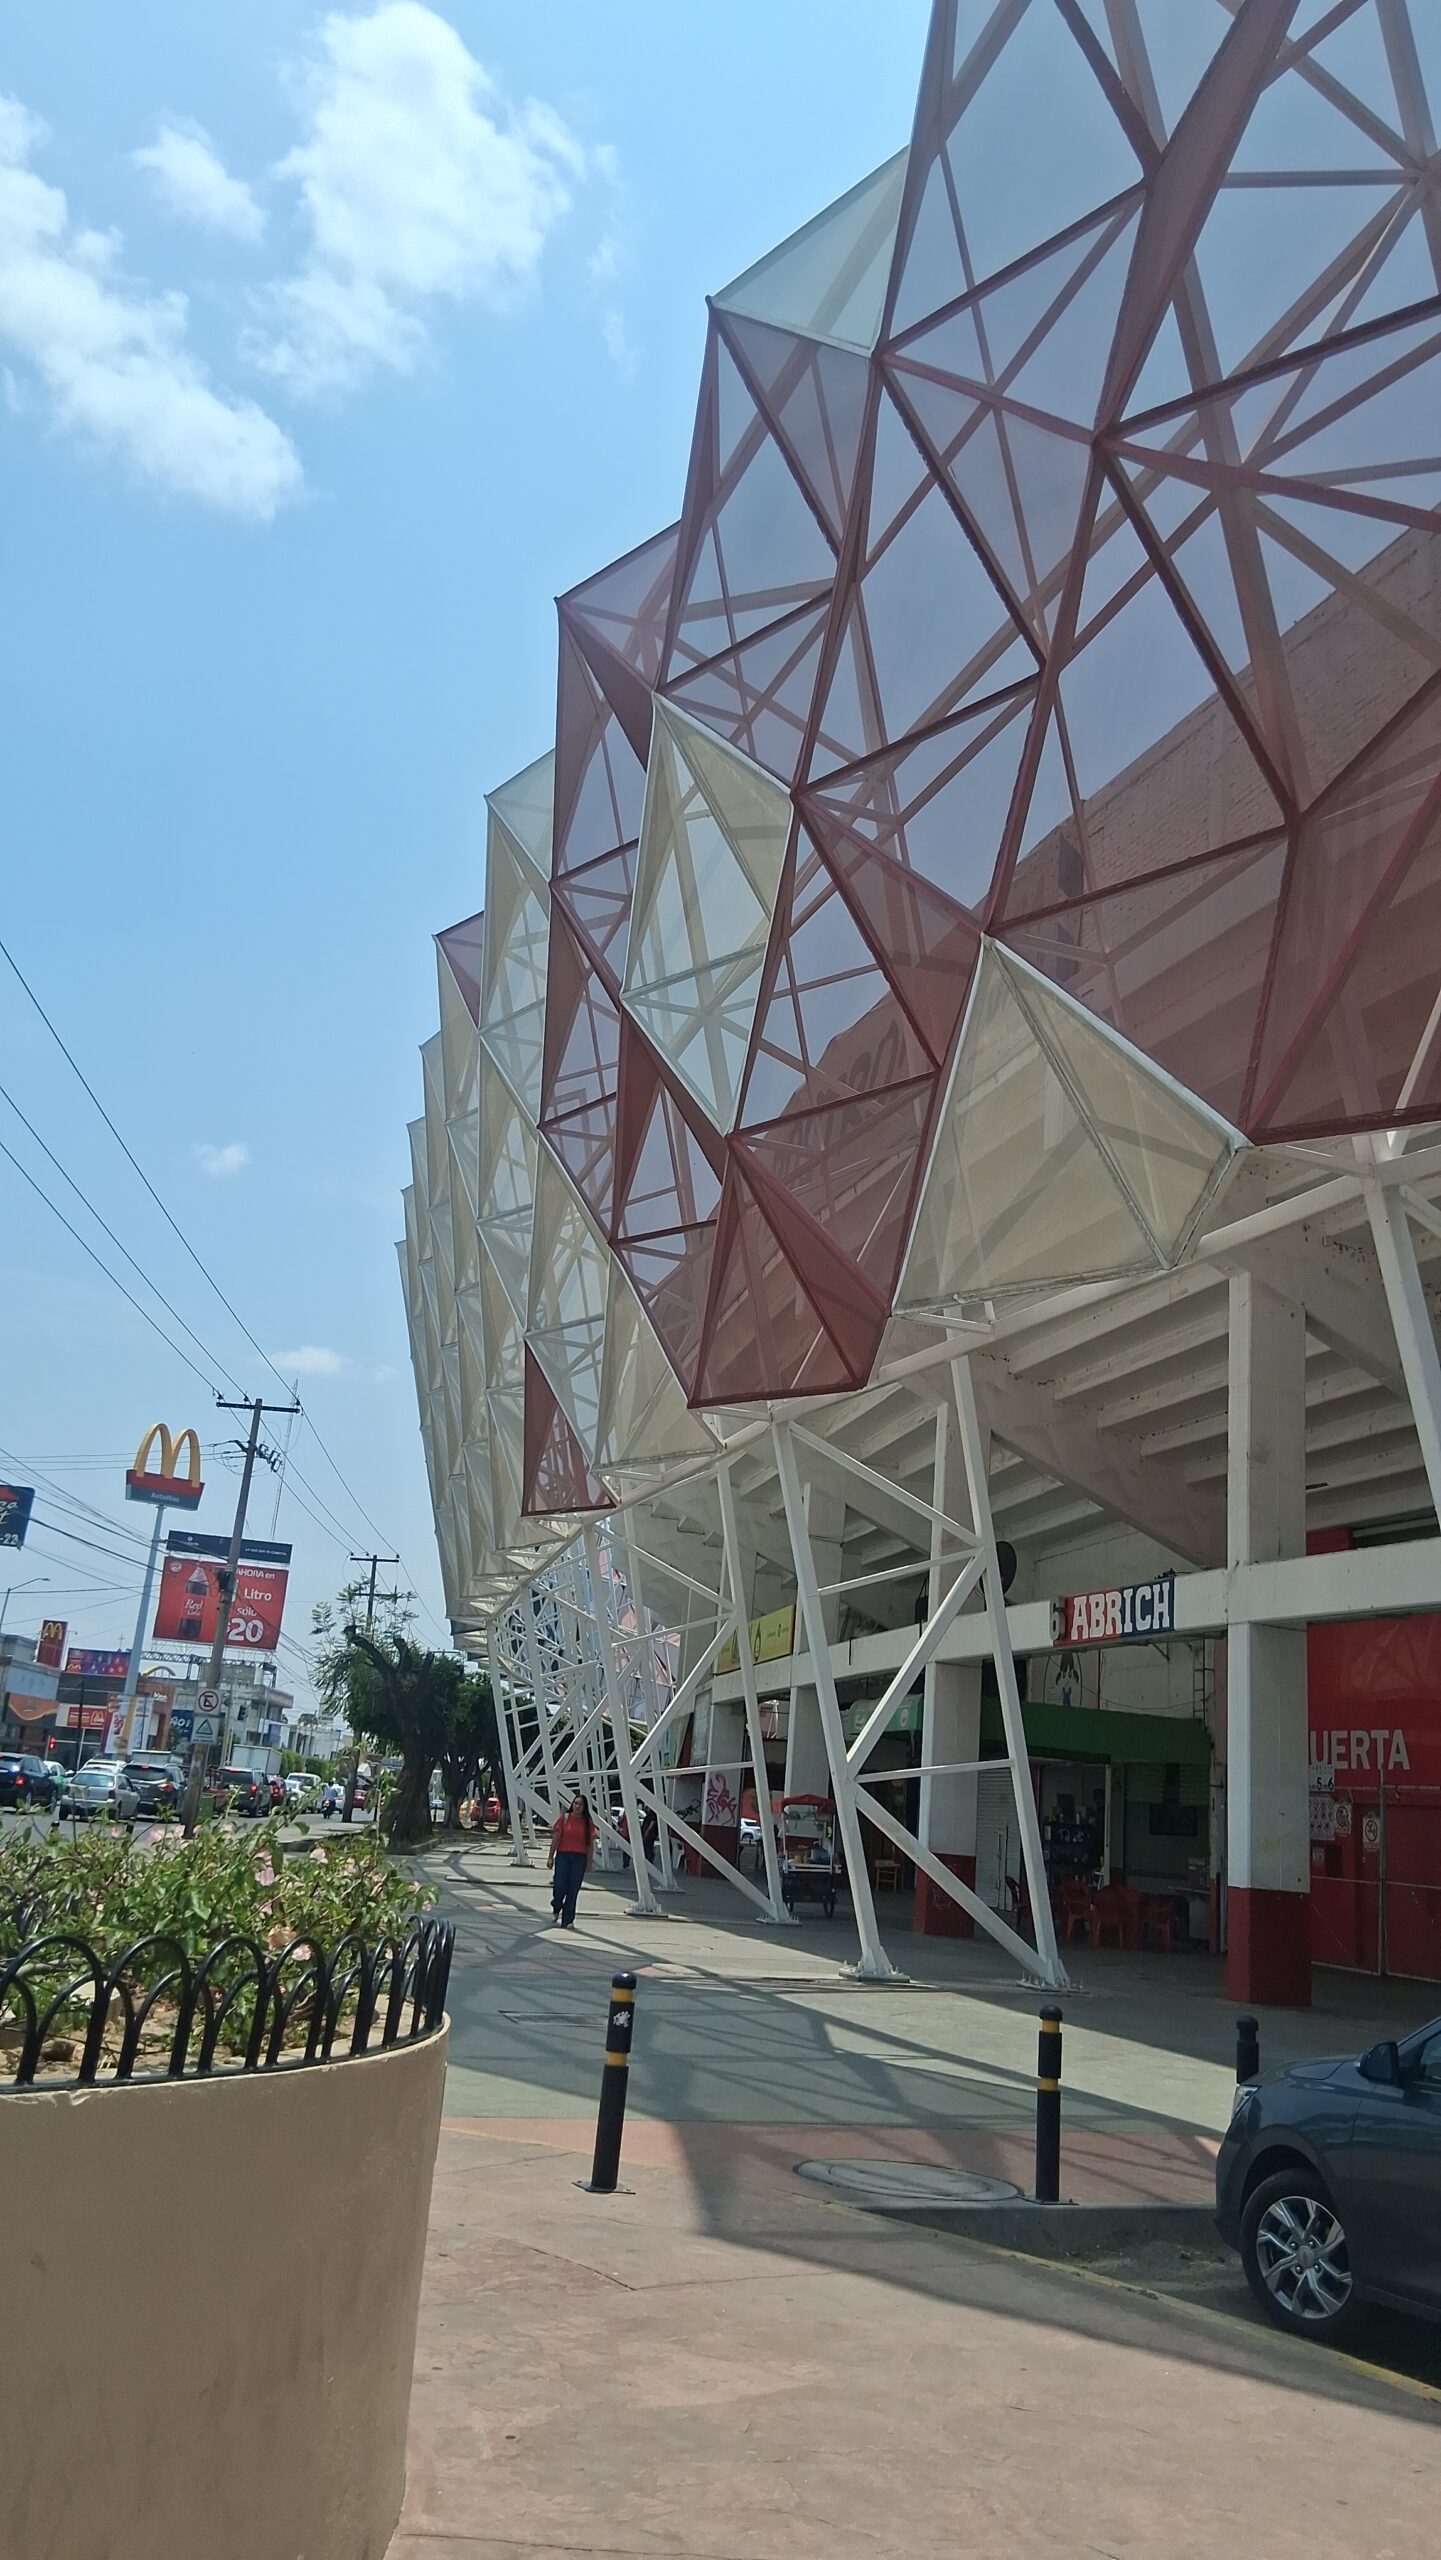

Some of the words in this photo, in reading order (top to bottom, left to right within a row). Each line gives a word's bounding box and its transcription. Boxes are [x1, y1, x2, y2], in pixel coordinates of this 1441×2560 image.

[244, 1588, 272, 1601] Litro
[1071, 1582, 1170, 1640] ABRICH
[1309, 1729, 1411, 1770] UERTA
